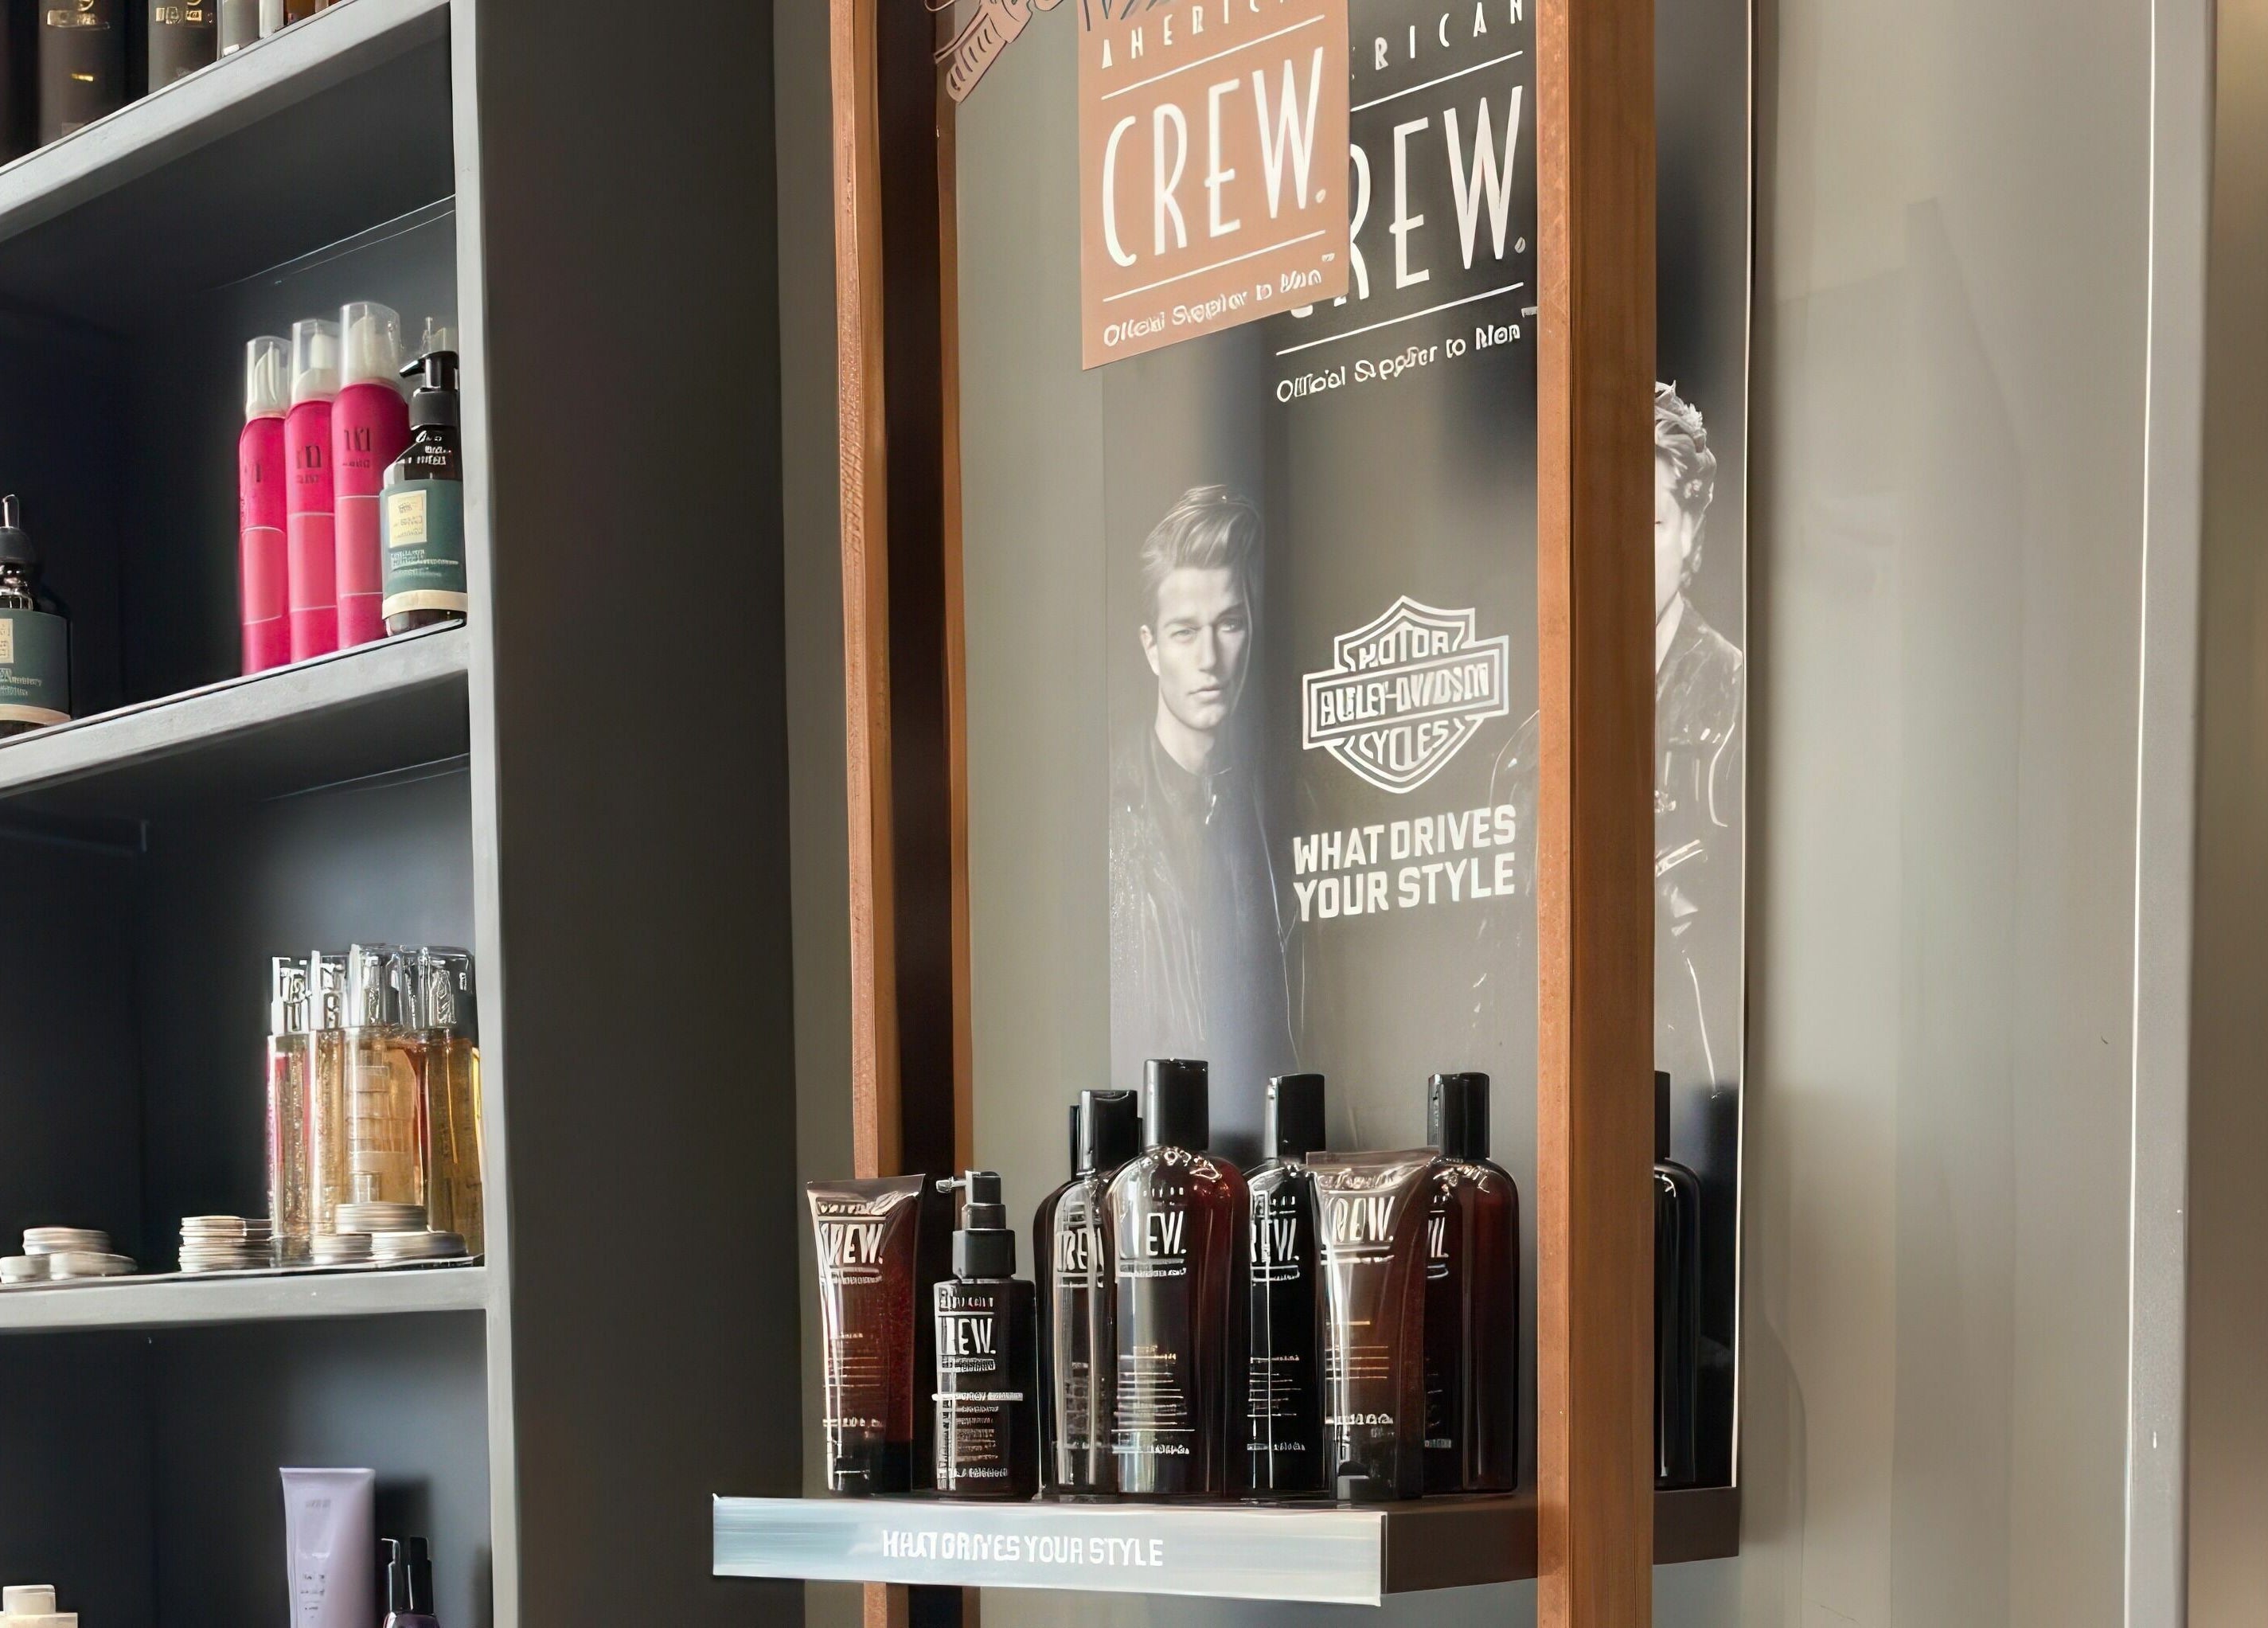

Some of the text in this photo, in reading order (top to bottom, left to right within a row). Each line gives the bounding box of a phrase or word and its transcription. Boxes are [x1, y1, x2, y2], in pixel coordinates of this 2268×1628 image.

[1290, 85, 1527, 318] REW.
[1293, 804, 1517, 875] WHAT DRIVES
[1293, 852, 1516, 922] YOUR STYLE
[1088, 1536, 1164, 1567] STYLE
